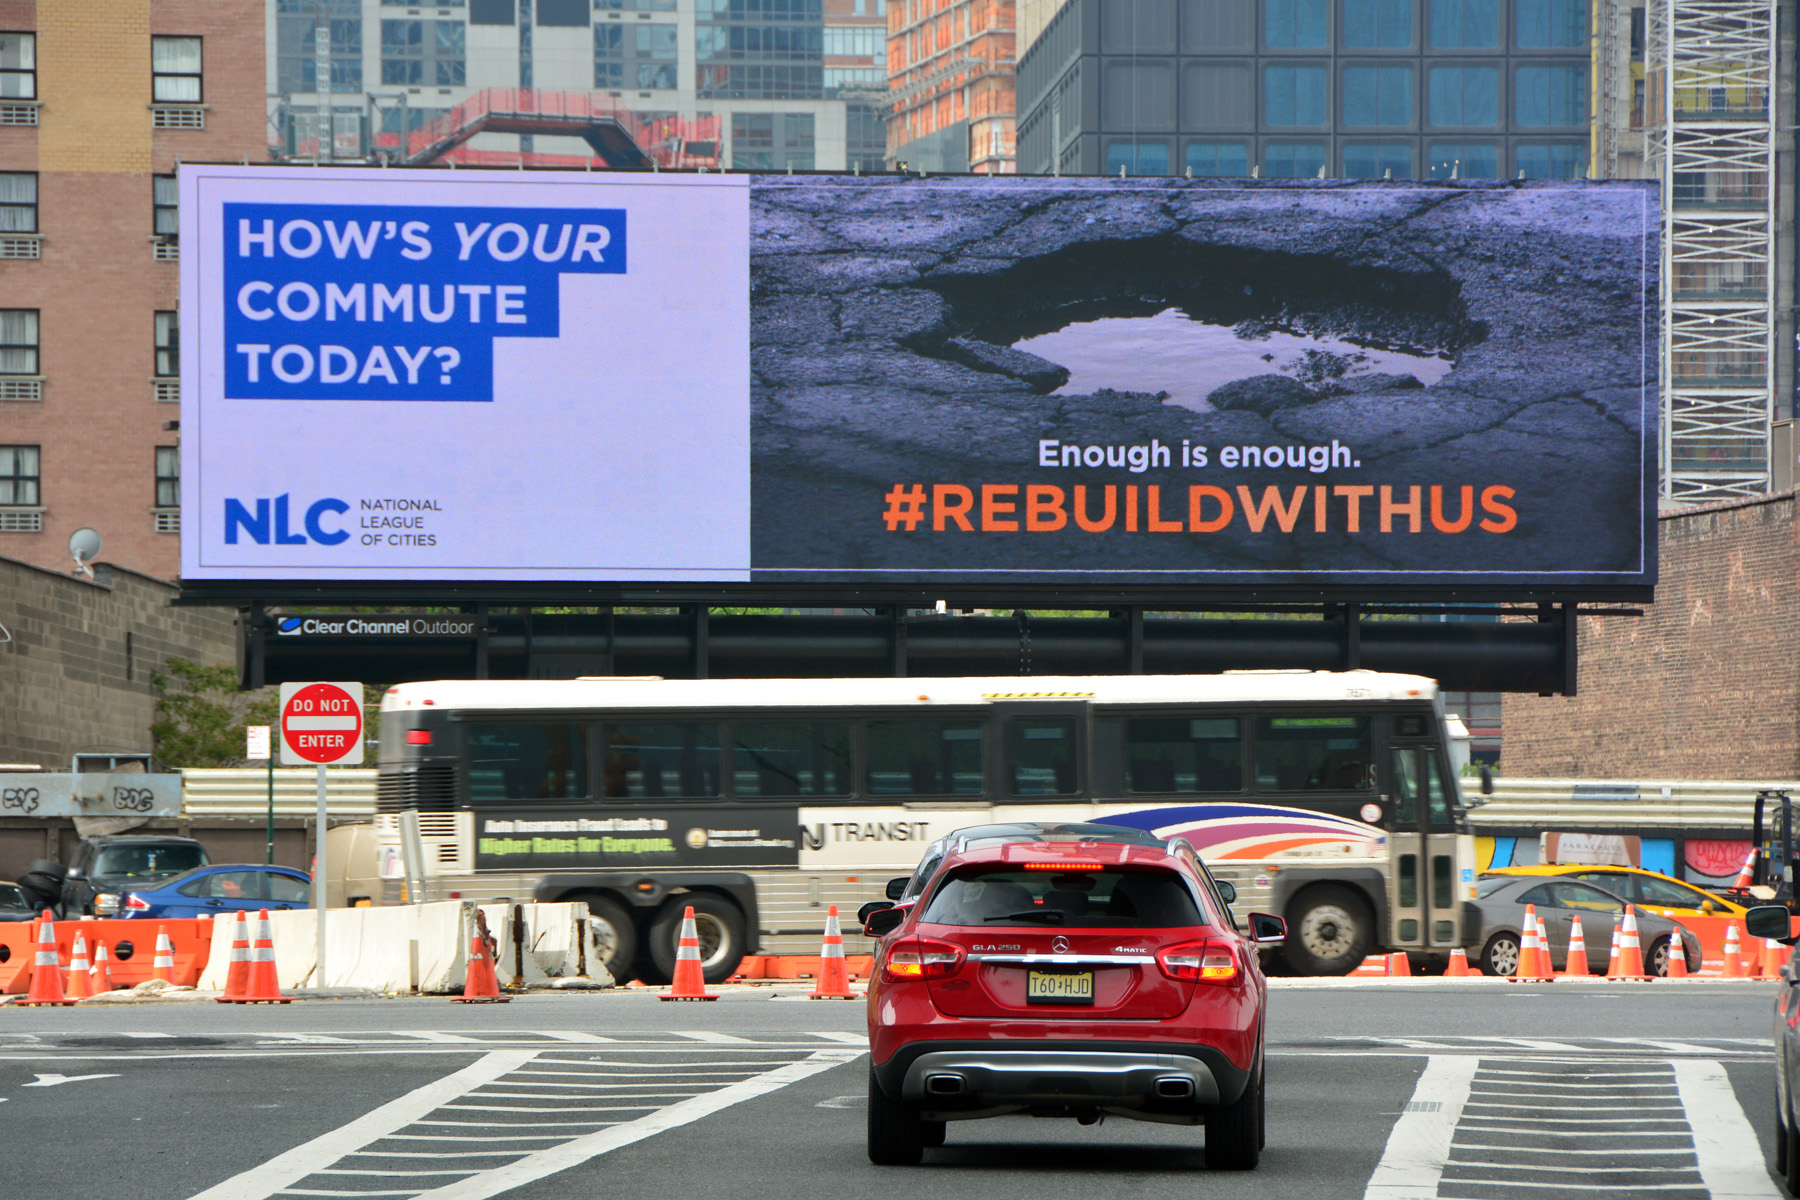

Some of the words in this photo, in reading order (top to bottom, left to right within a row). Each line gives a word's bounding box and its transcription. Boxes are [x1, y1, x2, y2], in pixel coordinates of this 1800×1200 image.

[238, 218, 432, 261] HOW'S
[454, 221, 612, 263] YOUR
[237, 280, 527, 324] COMMUTE
[236, 343, 461, 385] TODAY?
[1039, 439, 1170, 473] Enough
[1182, 439, 1208, 467] is
[1220, 440, 1360, 473] enough.
[360, 499, 442, 511] NATIONAL
[882, 483, 1518, 534] #REBUILDWITHUS
[224, 492, 351, 546] NLC
[360, 516, 424, 529] LEAGUE
[360, 534, 383, 546] OF
[387, 534, 437, 546] CITIES
[302, 619, 345, 634] Clear
[346, 619, 410, 634] Channel
[412, 619, 475, 634] Outdoor
[293, 699, 314, 712] DO
[320, 699, 350, 712] NOT
[298, 735, 345, 748] ENTER
[800, 822, 827, 851] NJ
[831, 822, 930, 842] TRANSIT
[1115, 945, 1147, 953] 4MATIC
[1064, 978, 1089, 994] HJD
